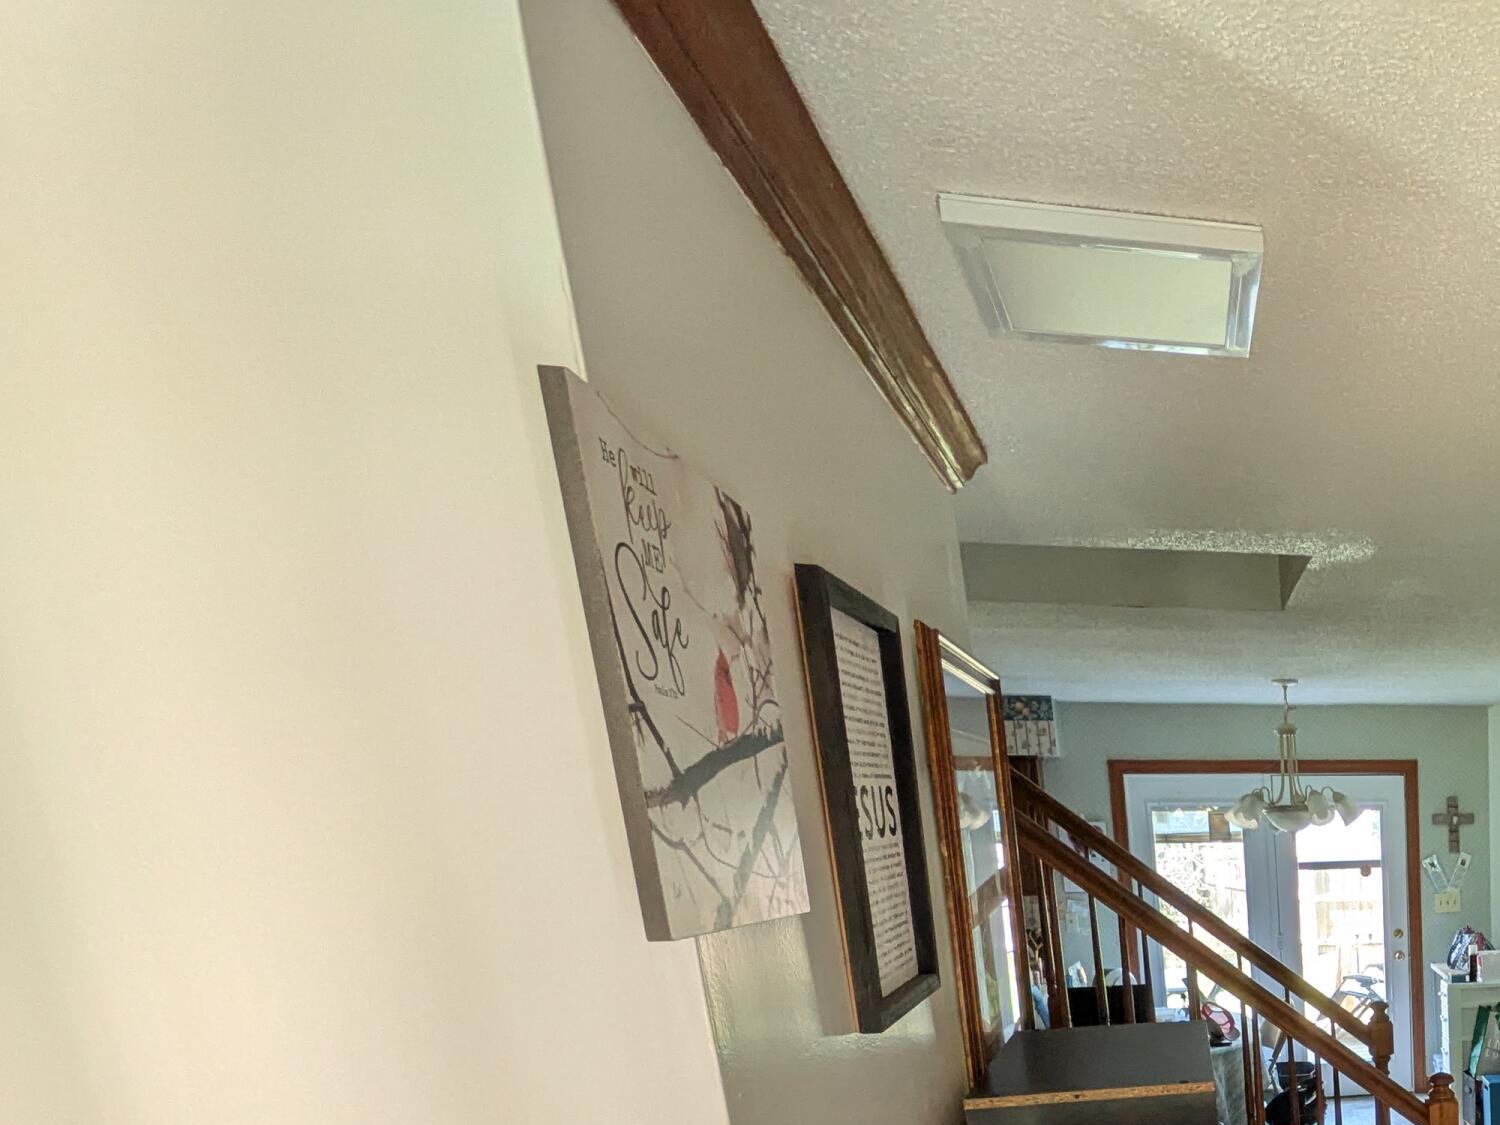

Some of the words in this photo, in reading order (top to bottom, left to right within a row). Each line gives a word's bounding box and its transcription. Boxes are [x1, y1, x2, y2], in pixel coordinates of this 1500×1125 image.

[599, 437, 616, 468] He
[630, 465, 657, 496] will
[618, 448, 672, 568] keep
[641, 539, 663, 574] ME
[615, 542, 689, 696] Safe
